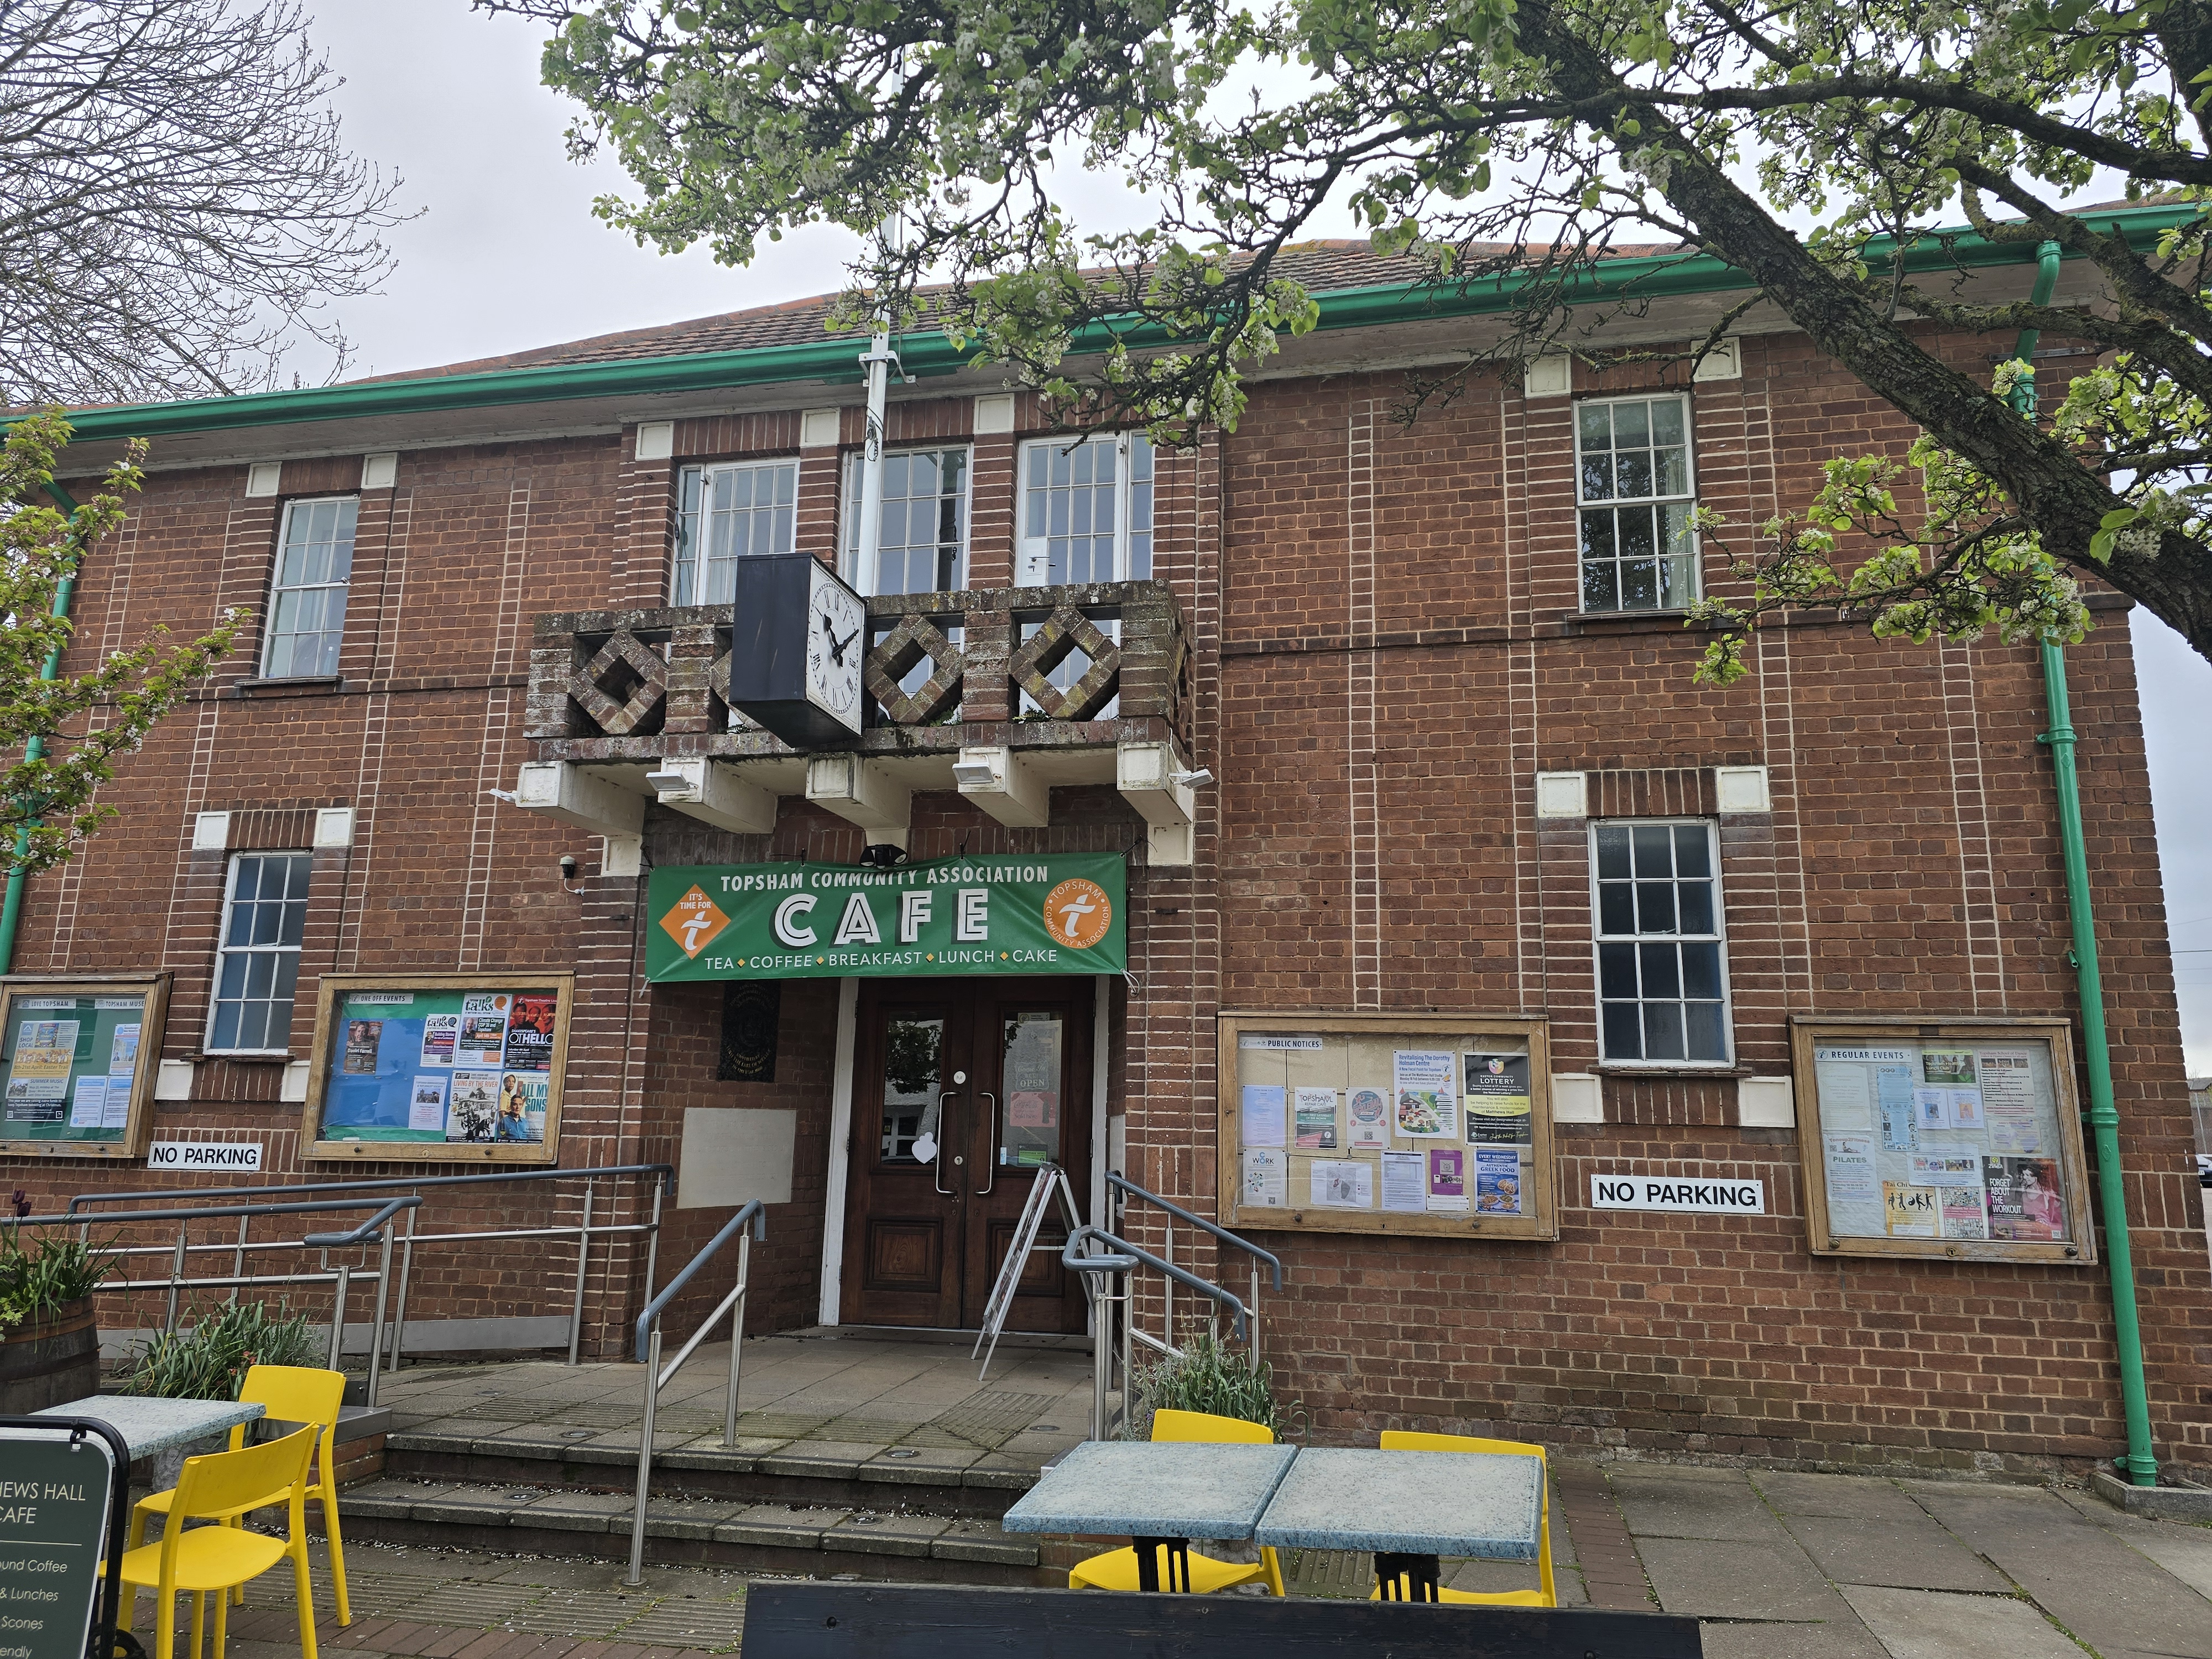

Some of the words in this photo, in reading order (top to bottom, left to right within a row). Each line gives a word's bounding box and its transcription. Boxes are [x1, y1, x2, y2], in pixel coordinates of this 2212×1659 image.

[721, 873, 803, 891] TOPSHAM
[811, 869, 917, 888] COMMUNITY
[926, 866, 1047, 884] ASSOCIATION
[1051, 881, 1102, 899] TOPSHAM
[774, 888, 988, 947] CAFE
[1046, 906, 1074, 945] COMMUNITY
[1077, 906, 1109, 947] ASSOCIATION
[705, 957, 734, 969] TEA
[750, 955, 812, 968] COFFEE
[829, 952, 922, 966] BREAKFAST
[939, 950, 994, 963] LUNCH
[1013, 950, 1057, 962] CAKE
[465, 999, 493, 1011] talks
[427, 1018, 447, 1026] talks
[509, 1033, 554, 1045] OTHELLO
[1020, 1079, 1045, 1087] OPEN
[521, 1084, 534, 1097] ALL
[525, 1098, 547, 1112] SONS
[153, 1147, 177, 1162] NO
[184, 1148, 257, 1165] PARKING
[1990, 1178, 2010, 1187] FORGET
[1599, 1182, 1635, 1202] NO
[1647, 1184, 1756, 1206] PARKING
[1991, 1187, 2010, 1196] ABOUT
[1991, 1196, 2004, 1204] THE
[1992, 1204, 2022, 1214] WORKOUT
[0, 1481, 39, 1499] EWS
[44, 1483, 86, 1501] HALL
[0, 1559, 25, 1571] und
[28, 1559, 67, 1573] Coffee
[0, 1587, 7, 1599] &
[11, 1587, 59, 1601] Lunches
[1, 1615, 44, 1630] Scones
